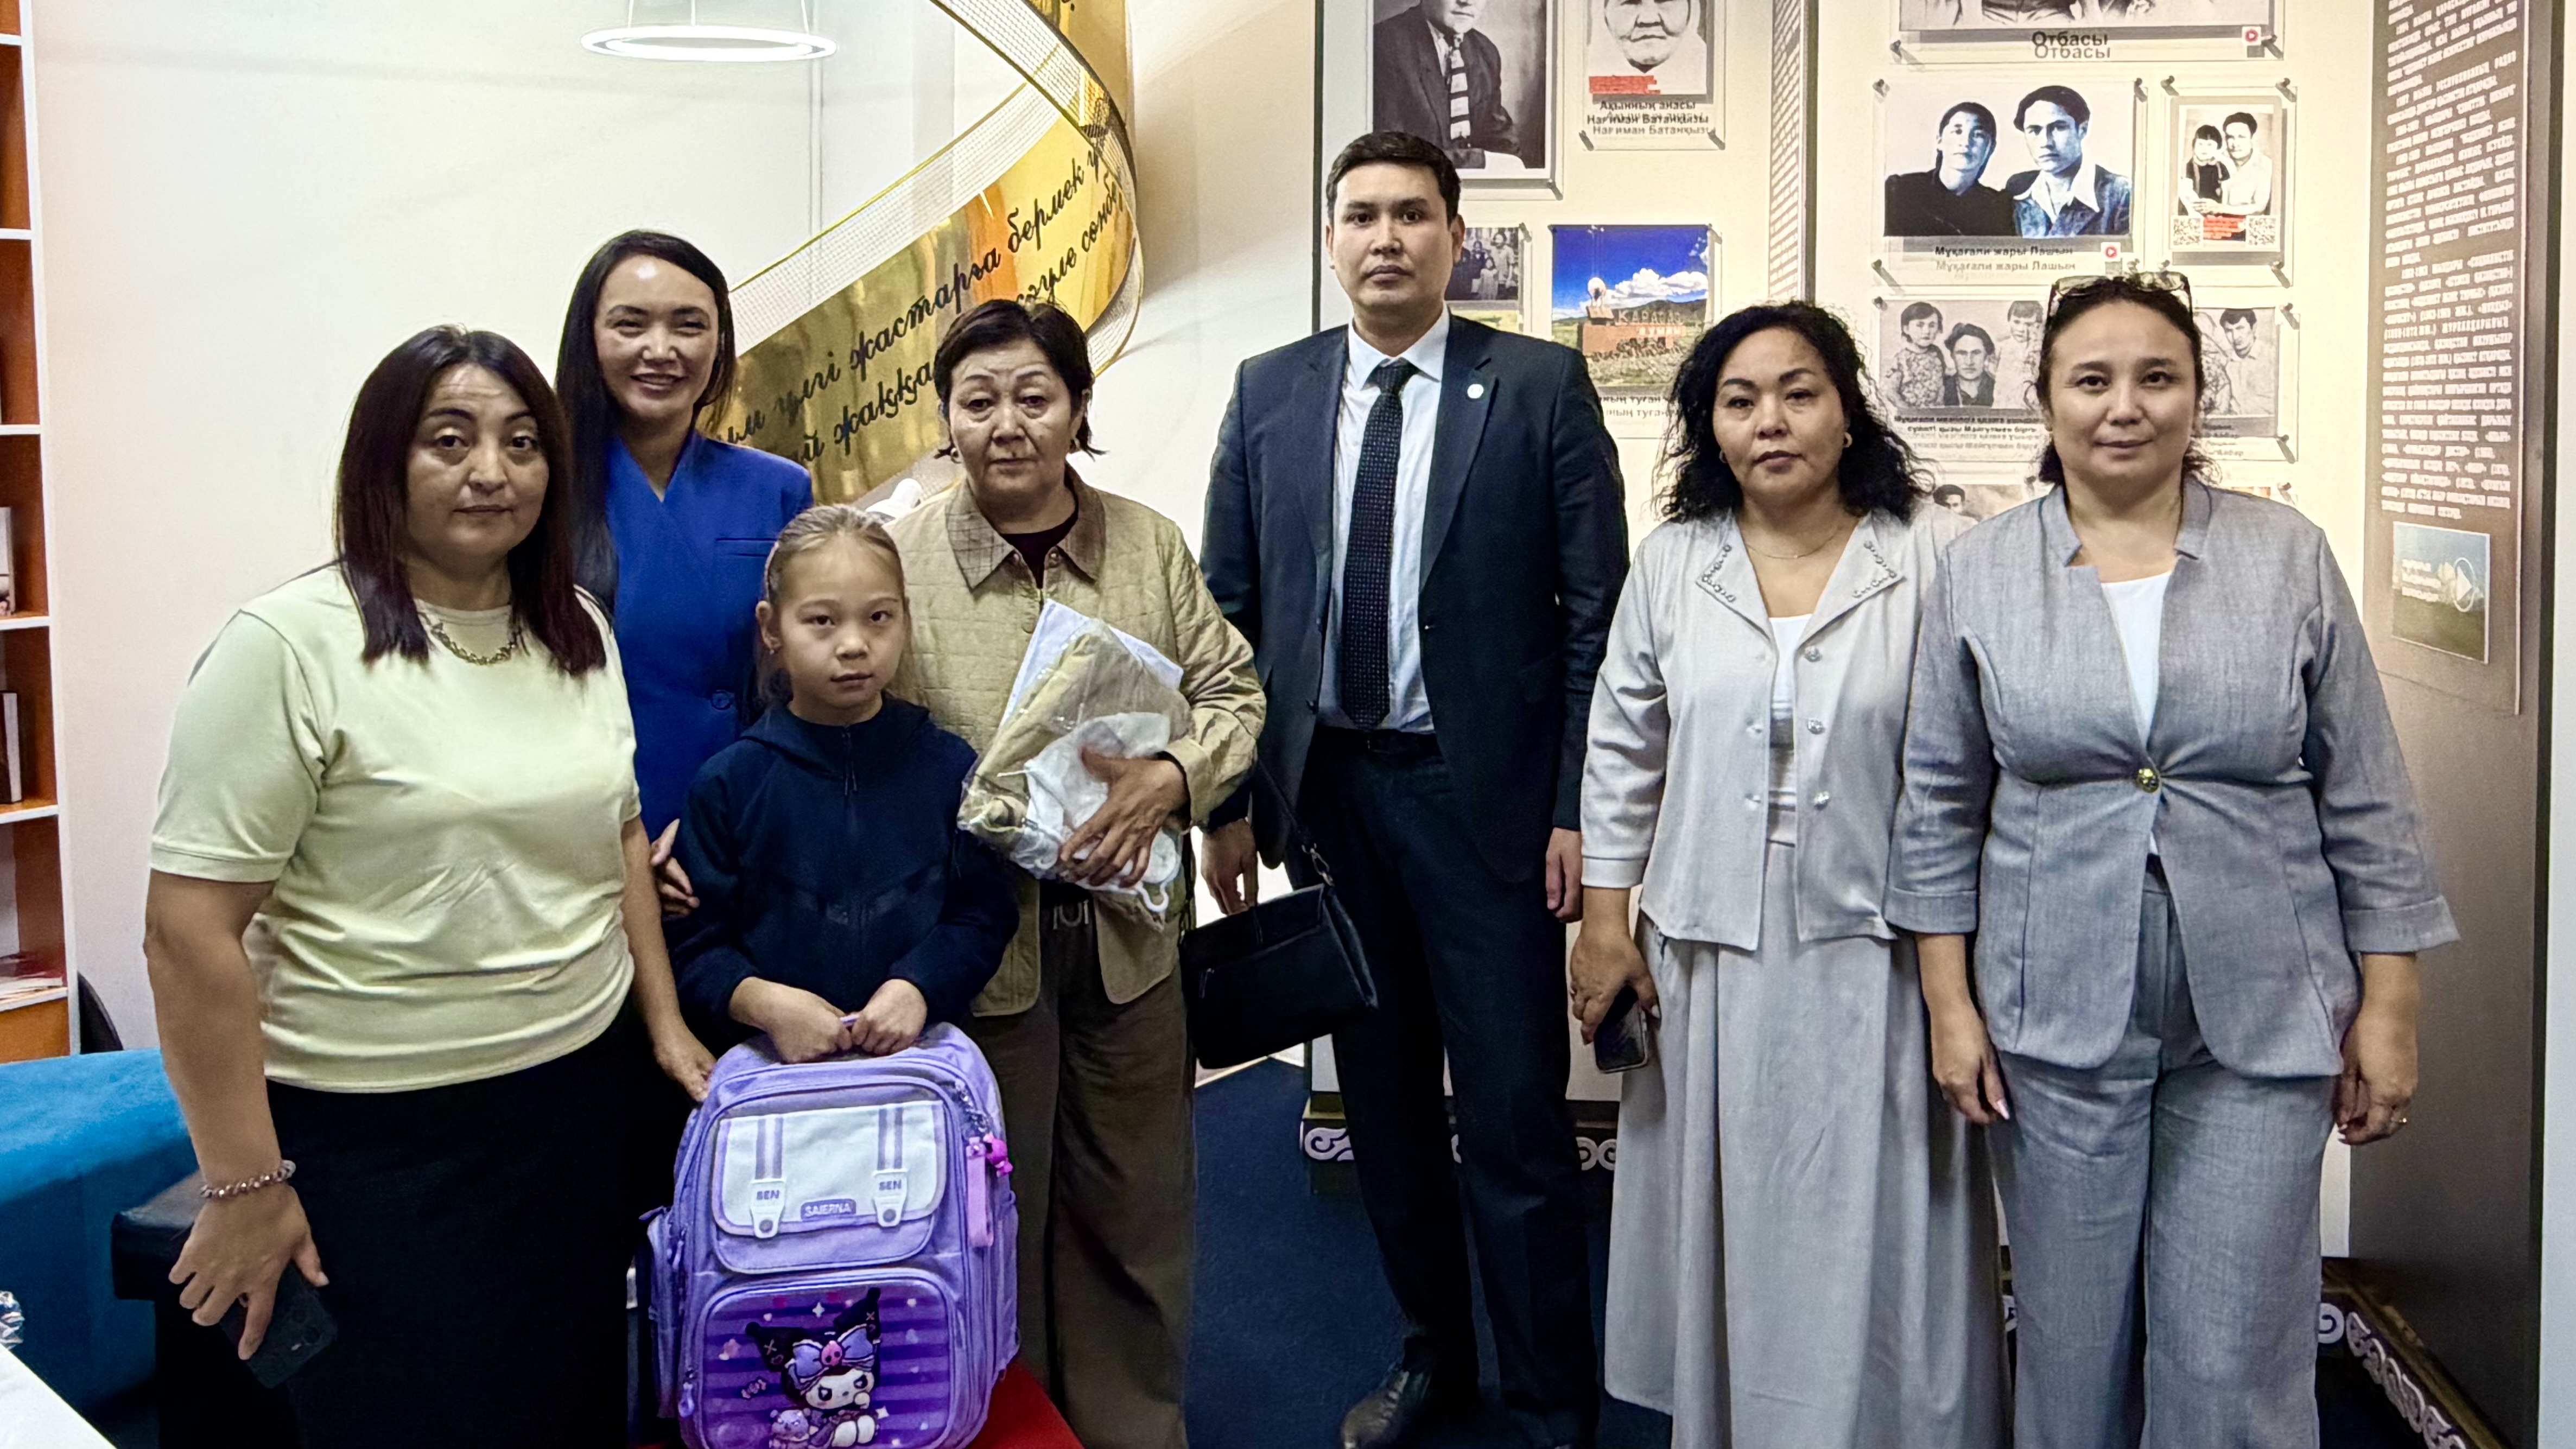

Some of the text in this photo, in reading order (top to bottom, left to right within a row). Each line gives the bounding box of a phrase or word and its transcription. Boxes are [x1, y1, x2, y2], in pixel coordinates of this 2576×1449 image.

[2032, 30, 2108, 46] Отбасы
[1659, 101, 1696, 110] анасы
[1007, 158, 1084, 251] бермек
[1994, 247, 2027, 258] жары
